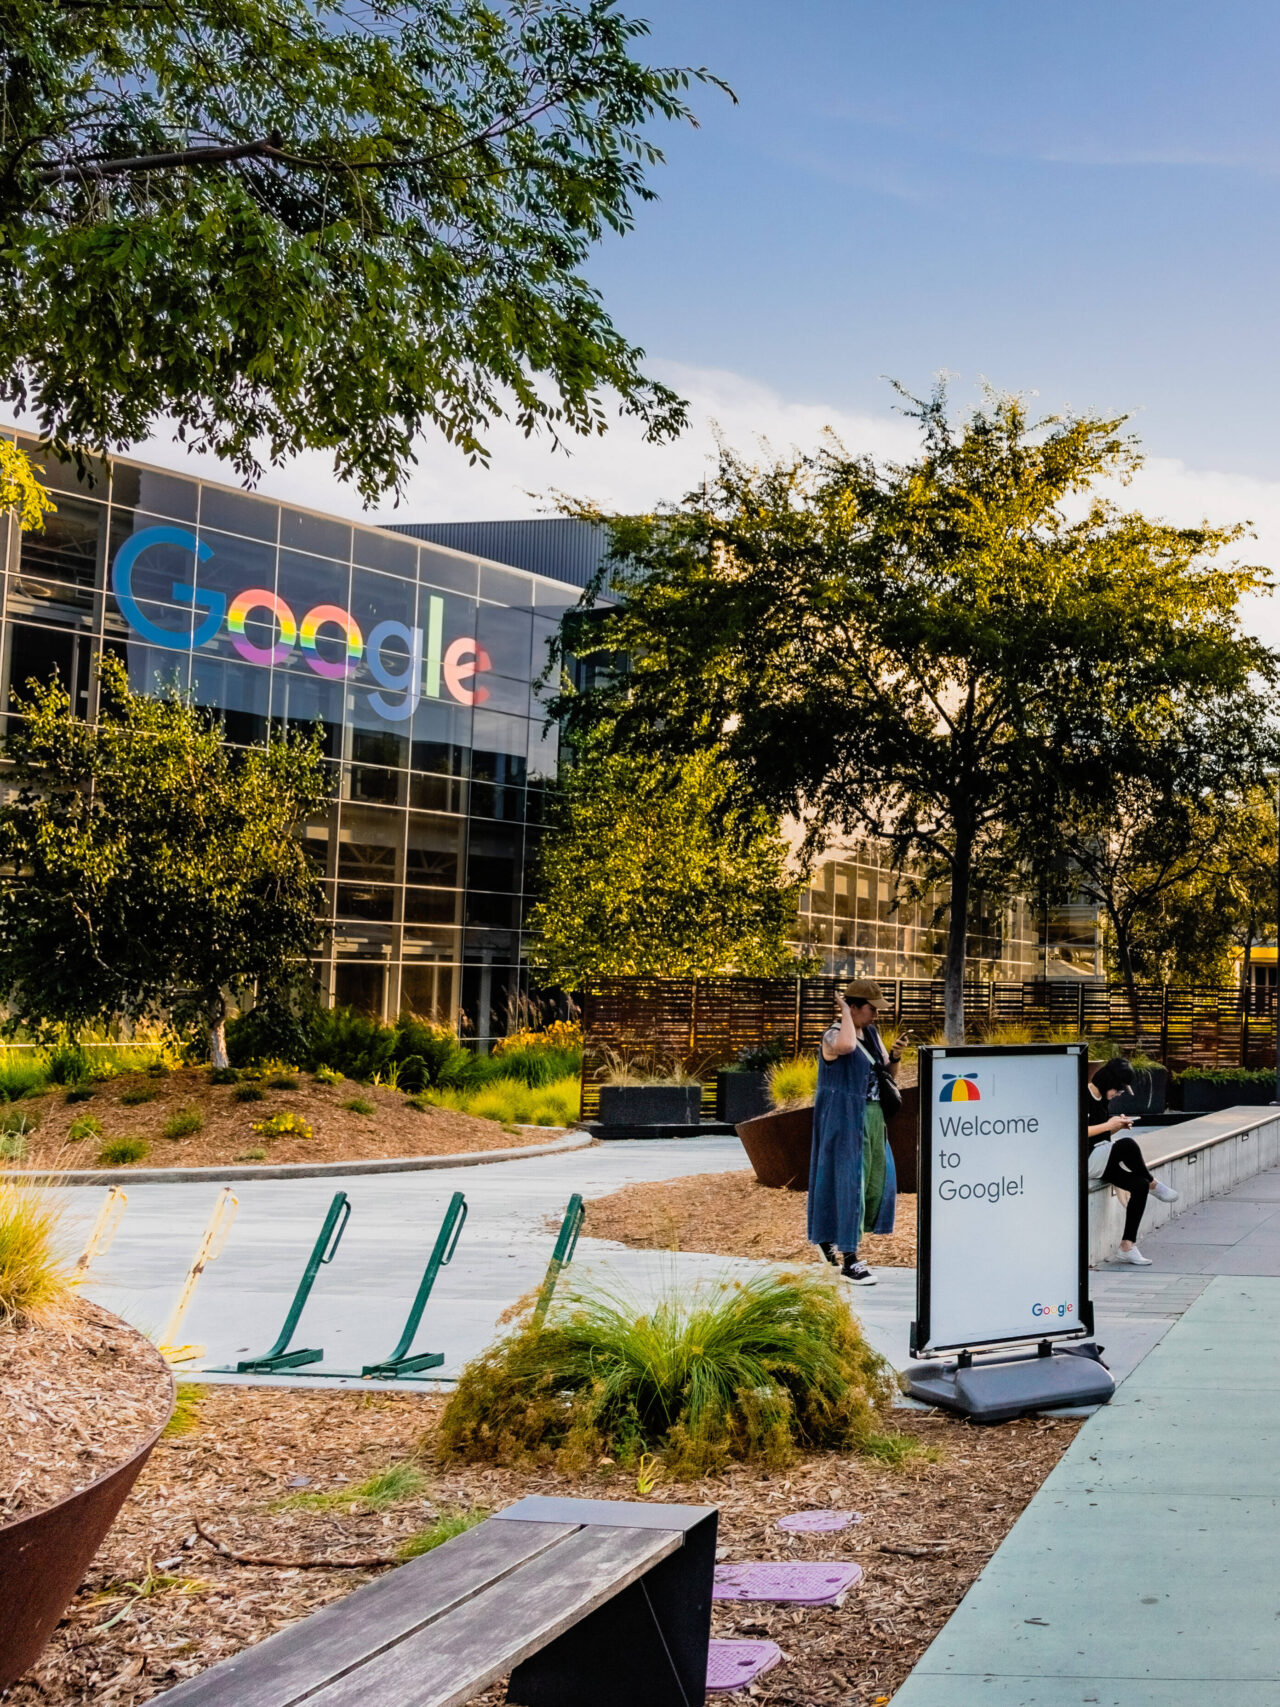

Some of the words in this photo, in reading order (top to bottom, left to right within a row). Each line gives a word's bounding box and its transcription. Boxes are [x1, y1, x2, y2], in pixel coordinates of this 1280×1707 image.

[111, 525, 492, 721] Google
[939, 1115, 1039, 1138] Welcome
[939, 1150, 961, 1168] to
[938, 1174, 1024, 1204] Google!
[1032, 1300, 1073, 1317] Google
